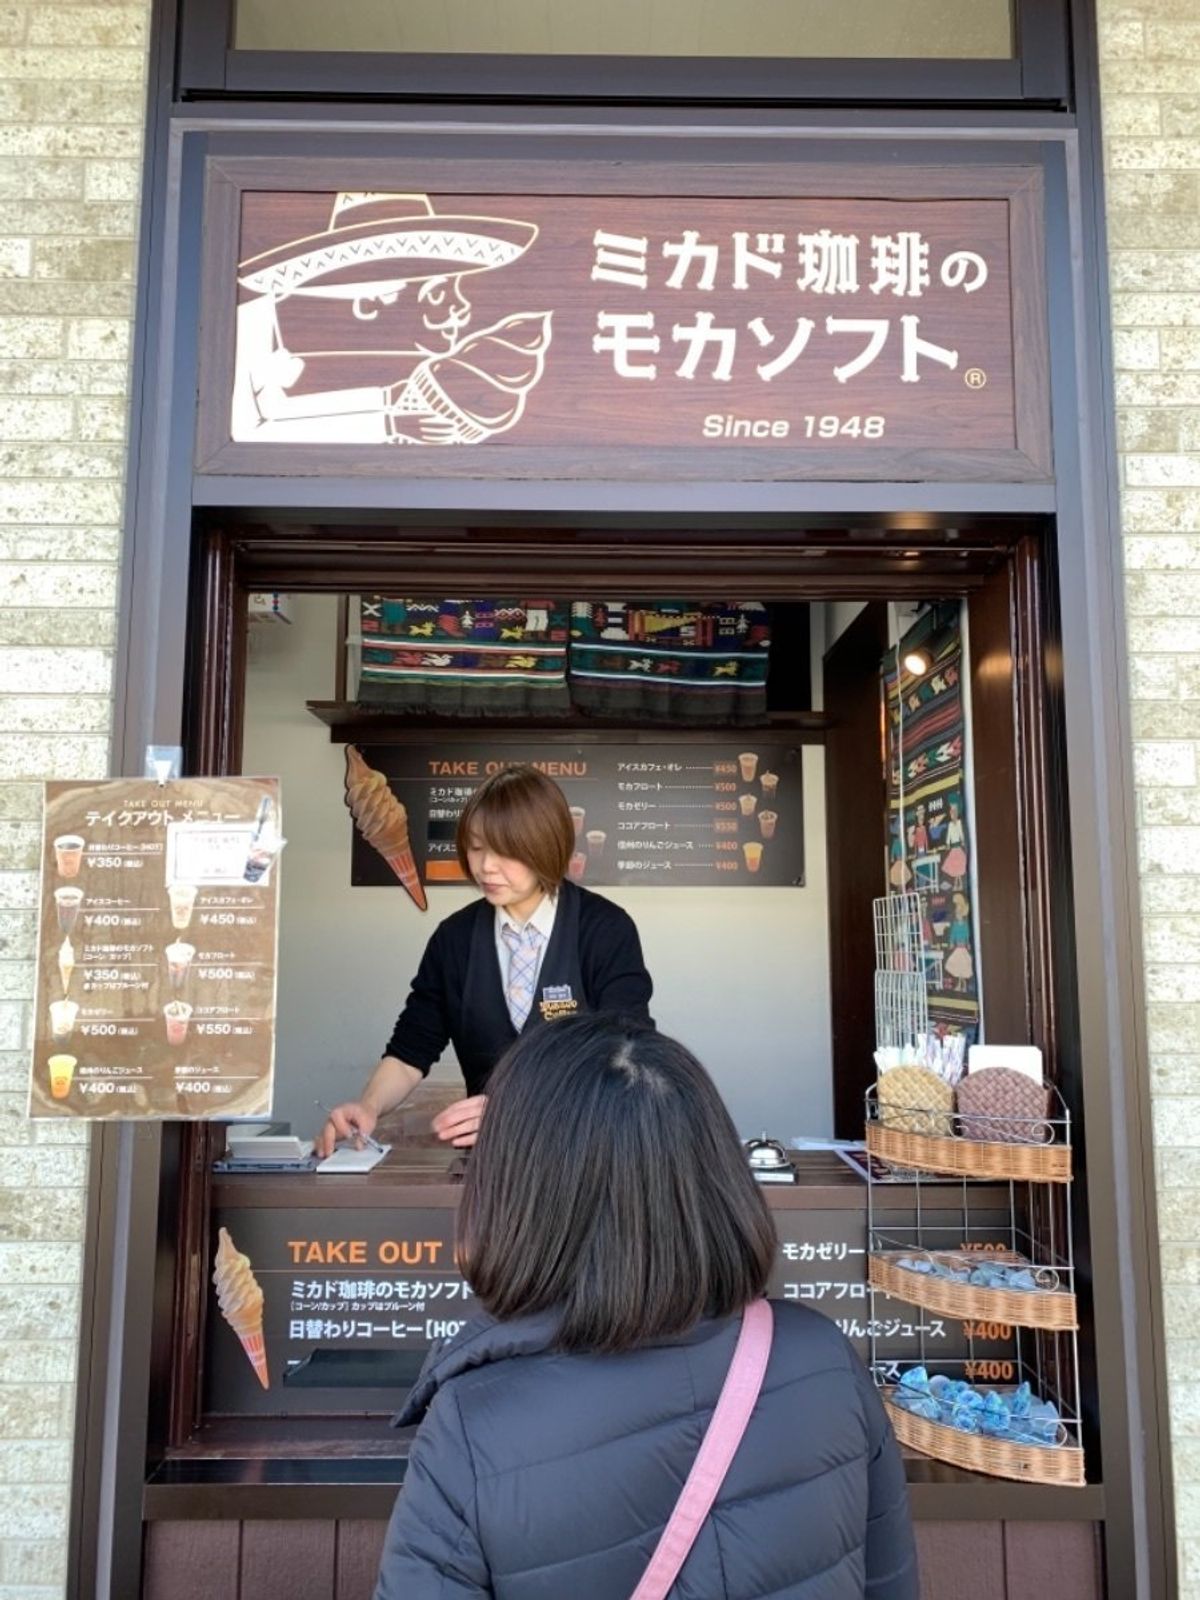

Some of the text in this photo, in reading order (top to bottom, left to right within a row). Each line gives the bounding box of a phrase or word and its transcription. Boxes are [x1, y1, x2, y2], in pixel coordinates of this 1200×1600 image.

[591, 229, 989, 296] ミカド珈琲の
[593, 310, 959, 383] モカソフト
[703, 414, 886, 439] Since 1948
[428, 761, 478, 775] TAKE
[86, 810, 173, 826] テイクアウト
[287, 1241, 368, 1264] TAKE
[378, 1241, 443, 1264] OUT
[782, 1243, 865, 1261] モカゼリー
[291, 1280, 475, 1299] ミカド珈琲のモカソフト
[963, 1321, 1012, 1340] ¥400
[964, 1361, 1013, 1380] ¥400
